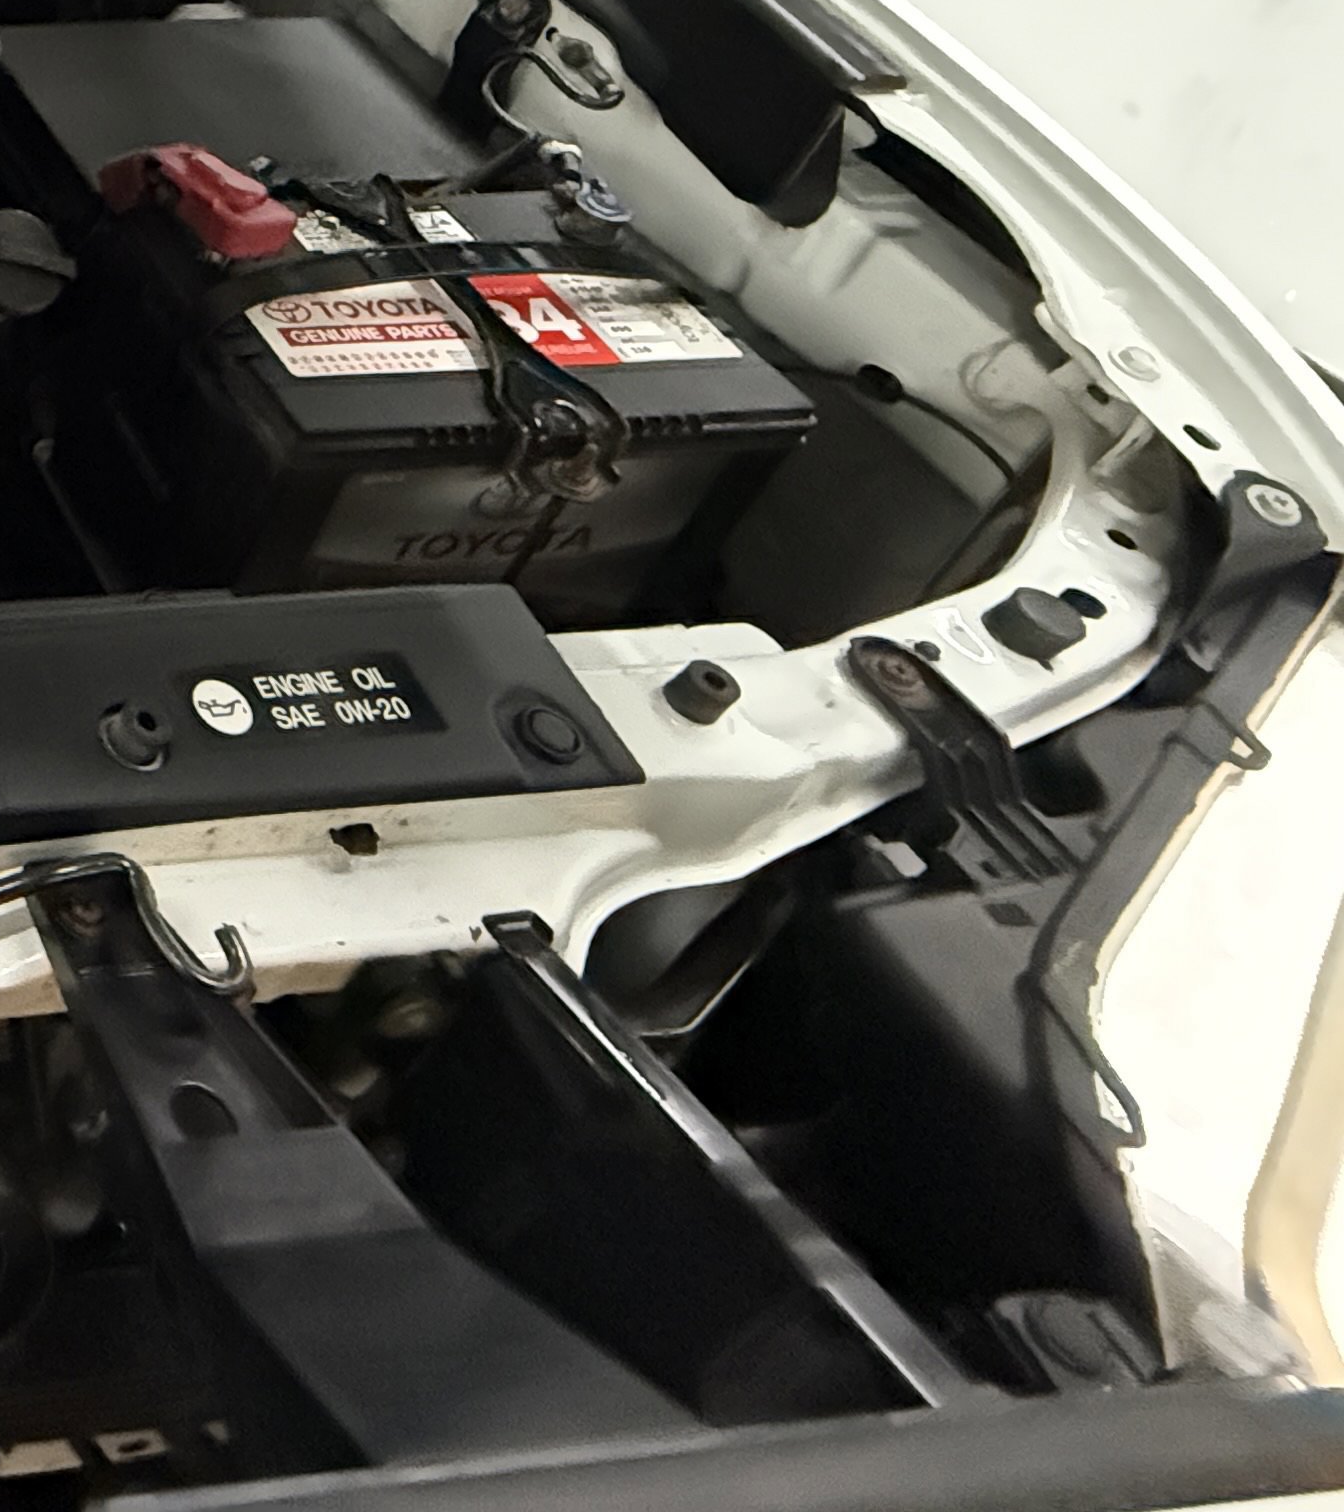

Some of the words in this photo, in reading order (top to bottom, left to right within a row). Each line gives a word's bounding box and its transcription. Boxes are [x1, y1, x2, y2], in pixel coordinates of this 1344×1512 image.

[313, 297, 447, 320] TOYOTA
[288, 323, 385, 344] GENUINE
[389, 321, 459, 340] PARTS
[252, 670, 345, 699] ENGINE
[351, 666, 397, 691] OIL
[271, 703, 327, 730] SAE
[334, 696, 412, 724] 0W-20
